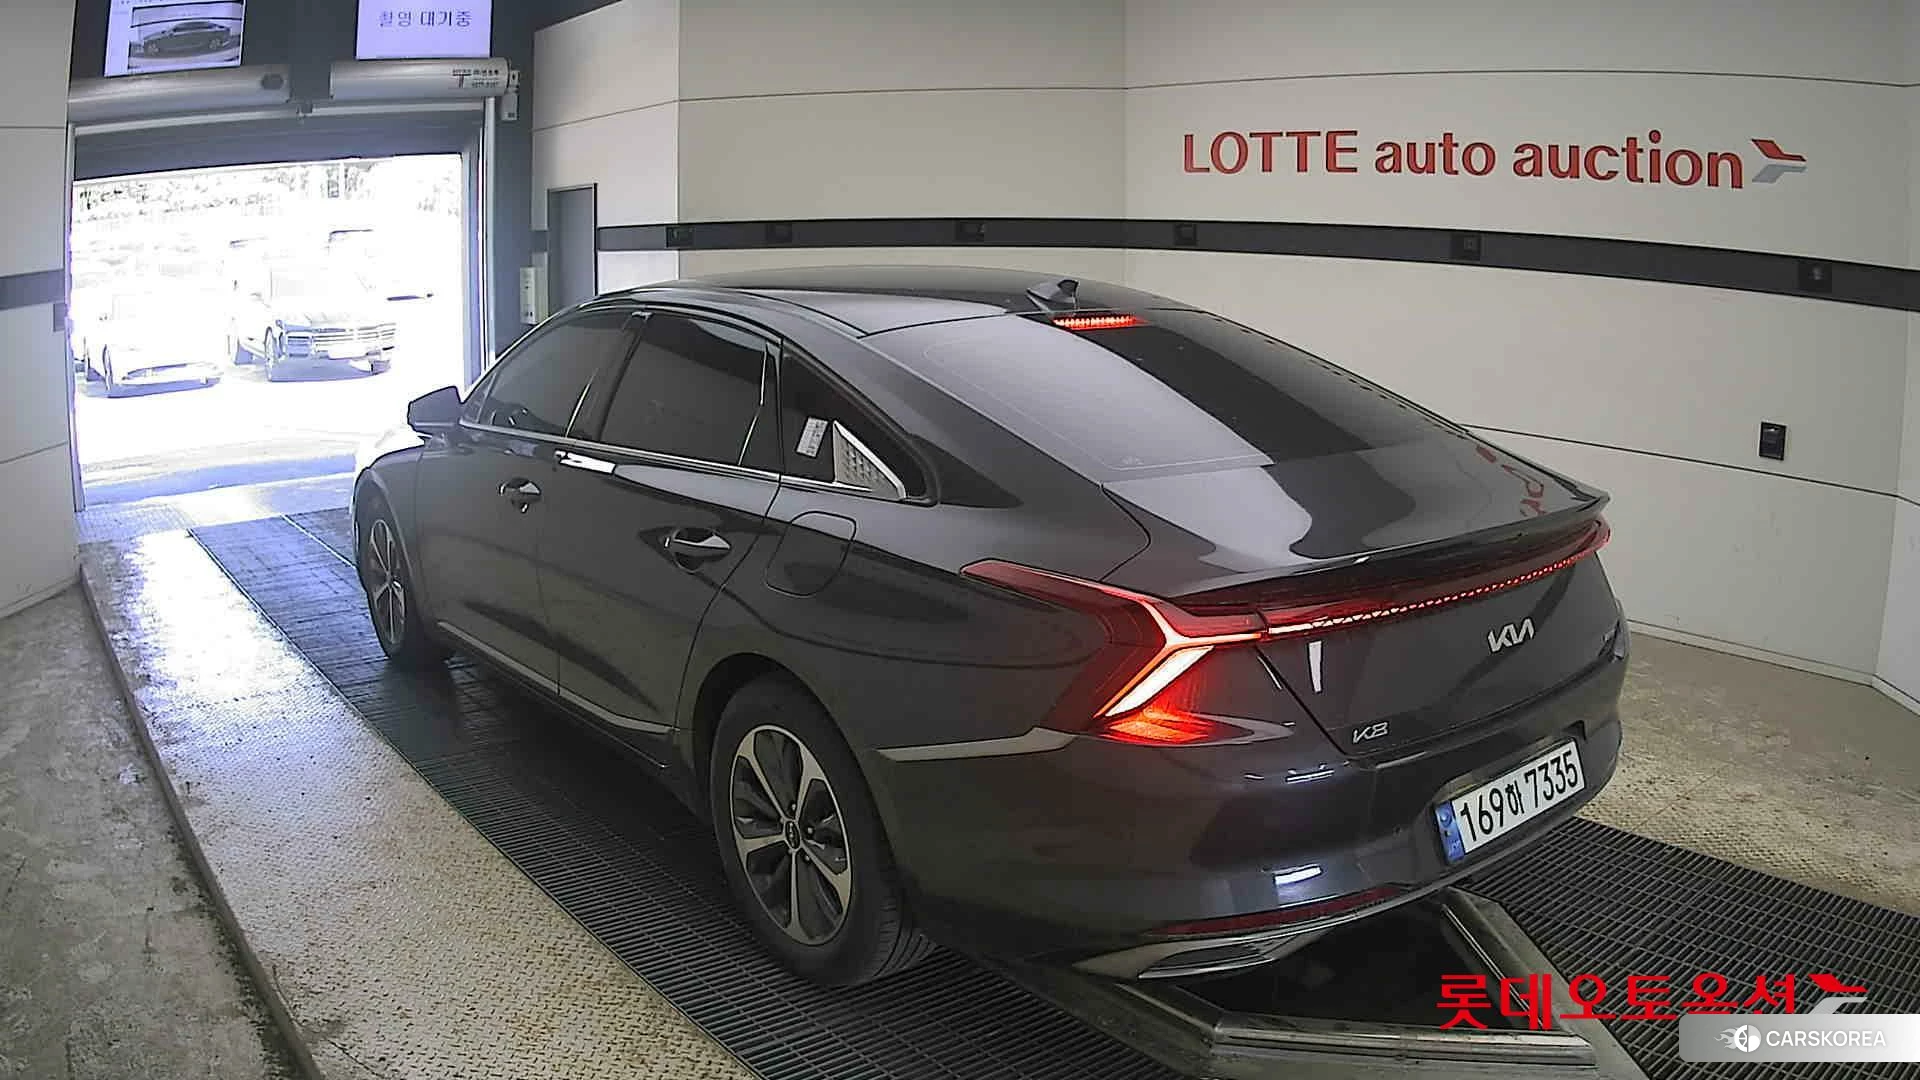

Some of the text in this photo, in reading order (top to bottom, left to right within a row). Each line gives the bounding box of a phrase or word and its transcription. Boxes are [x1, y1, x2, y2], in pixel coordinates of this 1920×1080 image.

[419, 10, 472, 27] 대기중
[1184, 130, 1743, 189] LOTTE auto auction
[1352, 721, 1389, 744] K8
[1460, 750, 1579, 842] 169하 7335
